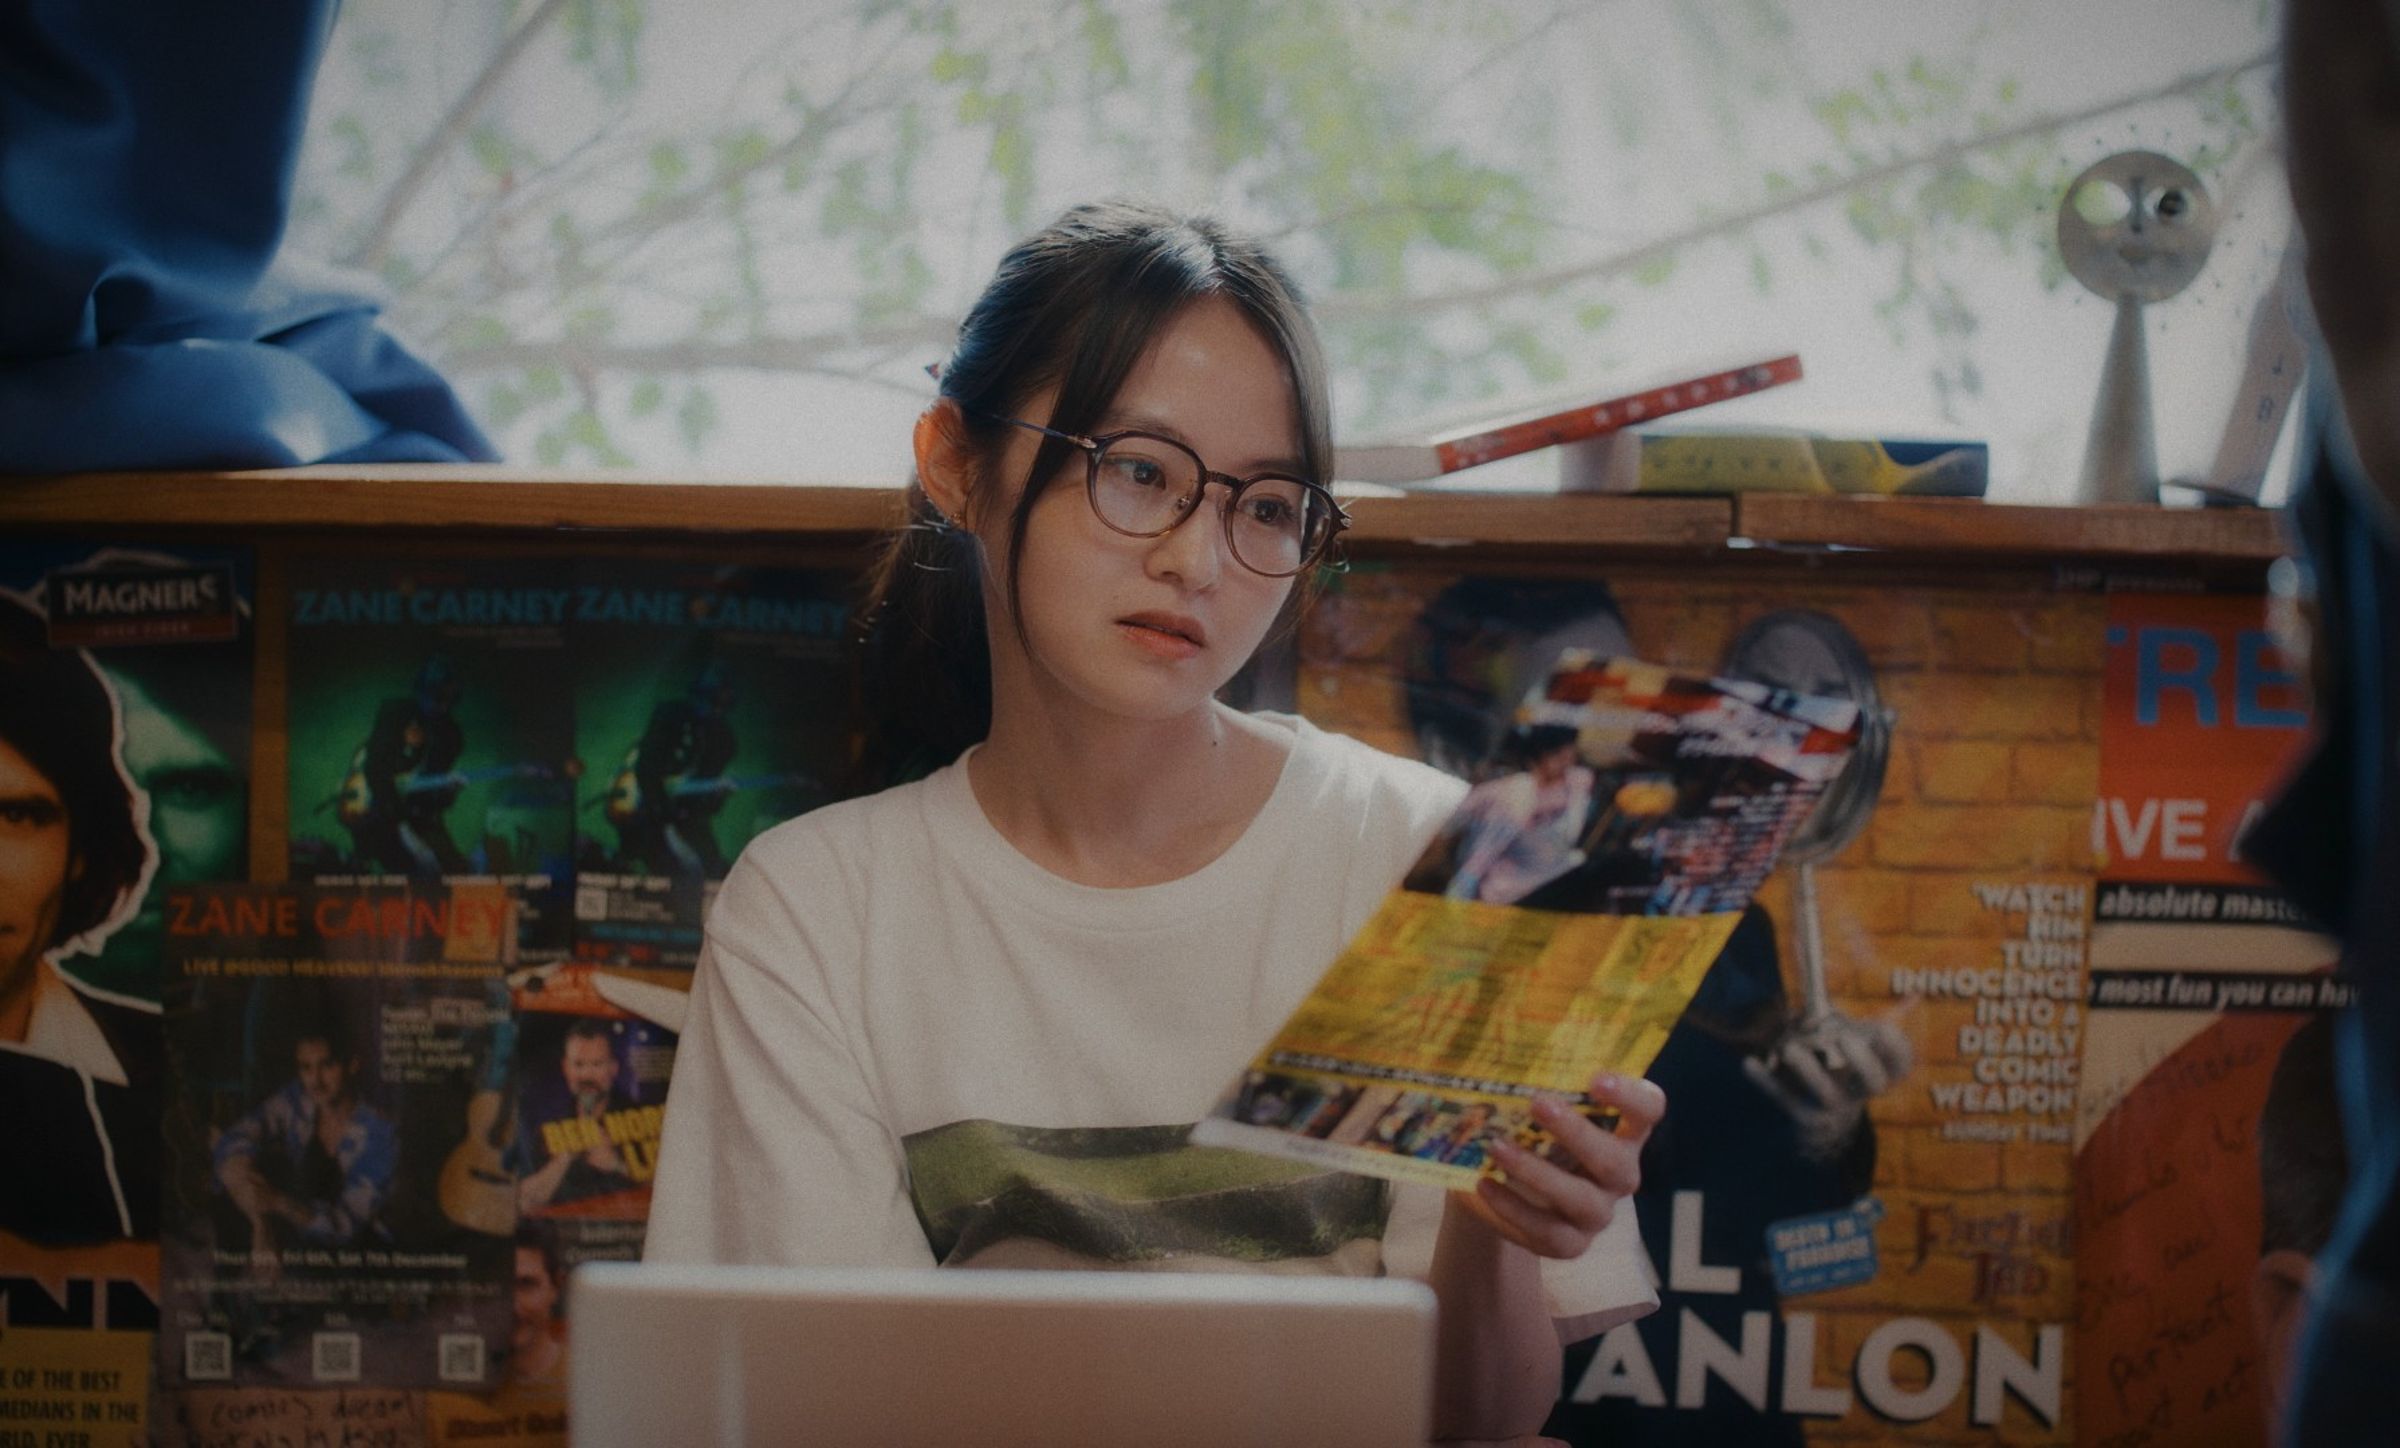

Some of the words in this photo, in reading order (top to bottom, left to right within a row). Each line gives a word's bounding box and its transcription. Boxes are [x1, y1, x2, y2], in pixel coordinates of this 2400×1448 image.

[293, 589, 402, 625] ZANE
[408, 588, 569, 625] CARNEY
[575, 586, 686, 625] ZANE
[167, 896, 299, 937] ZANE
[313, 895, 507, 939] CARNEY
[2101, 885, 2216, 919] absolute
[2219, 891, 2307, 922] maste
[2027, 914, 2085, 942] HIM
[182, 955, 219, 977] LIVE
[2002, 940, 2084, 970] TURN
[1891, 966, 2082, 999] INNOCENCE
[2100, 976, 2163, 1003] most
[2166, 974, 2213, 1004] fun
[2212, 980, 2268, 1014] you
[2268, 981, 2316, 1007] can
[1974, 997, 2056, 1027] INTO
[2062, 1001, 2081, 1028] A
[1958, 1023, 2079, 1056] DEADLY
[1973, 1055, 2081, 1086] COMIC
[1930, 1082, 2076, 1114] WEAPON
[392, 1250, 468, 1271] December
[12, 1367, 36, 1390] OF
[43, 1369, 75, 1391] THE
[79, 1369, 121, 1392] BEST
[81, 1402, 101, 1422] IN
[107, 1402, 139, 1423] THE
